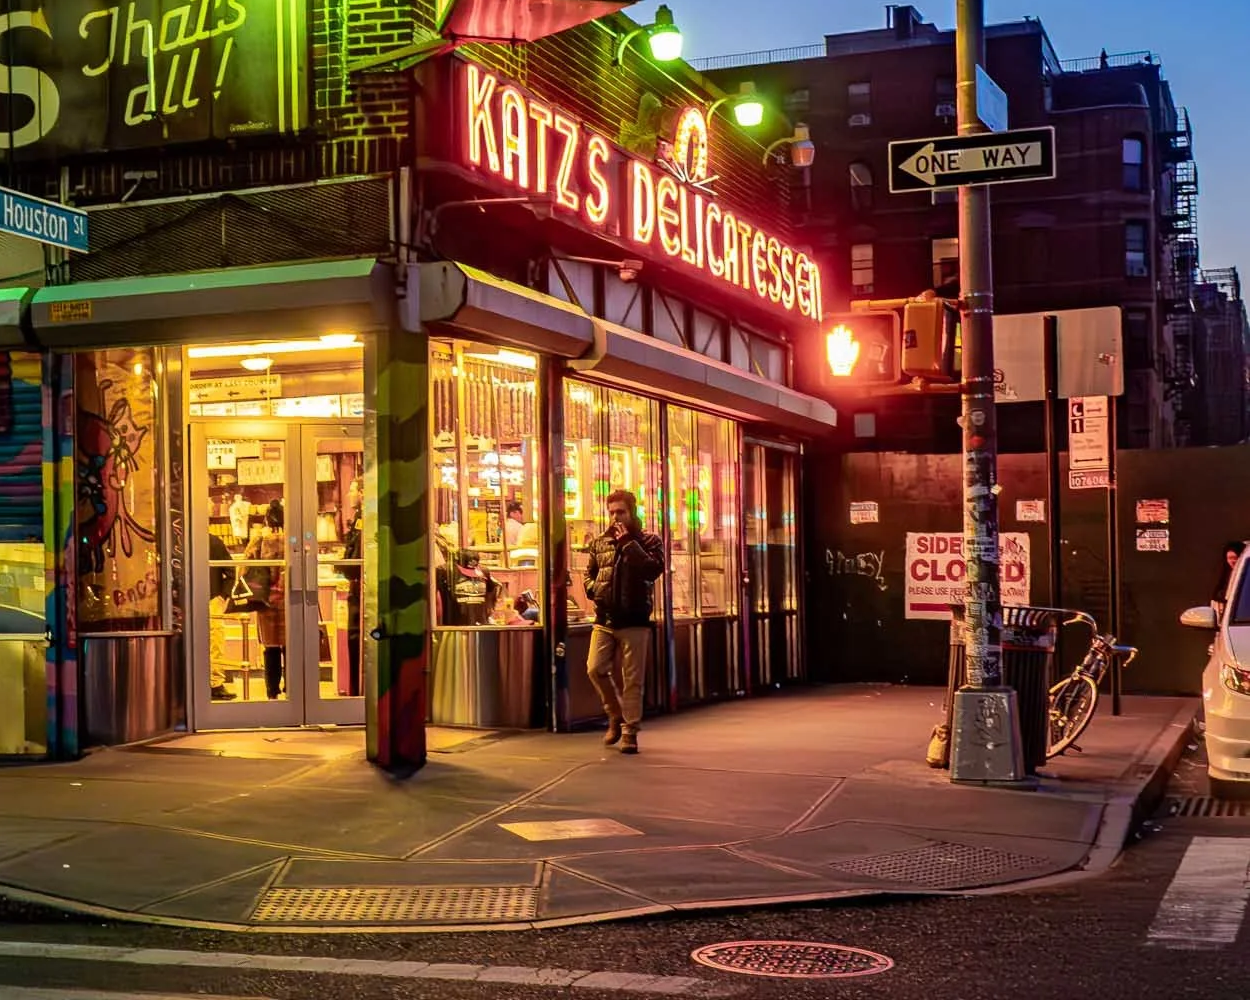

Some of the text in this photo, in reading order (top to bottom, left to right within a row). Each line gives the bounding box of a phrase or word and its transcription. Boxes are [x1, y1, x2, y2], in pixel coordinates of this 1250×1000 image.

[916, 145, 1031, 174] ONE WAY
[3, 196, 69, 243] Houston
[73, 213, 85, 236] St
[935, 587, 948, 596] USE
